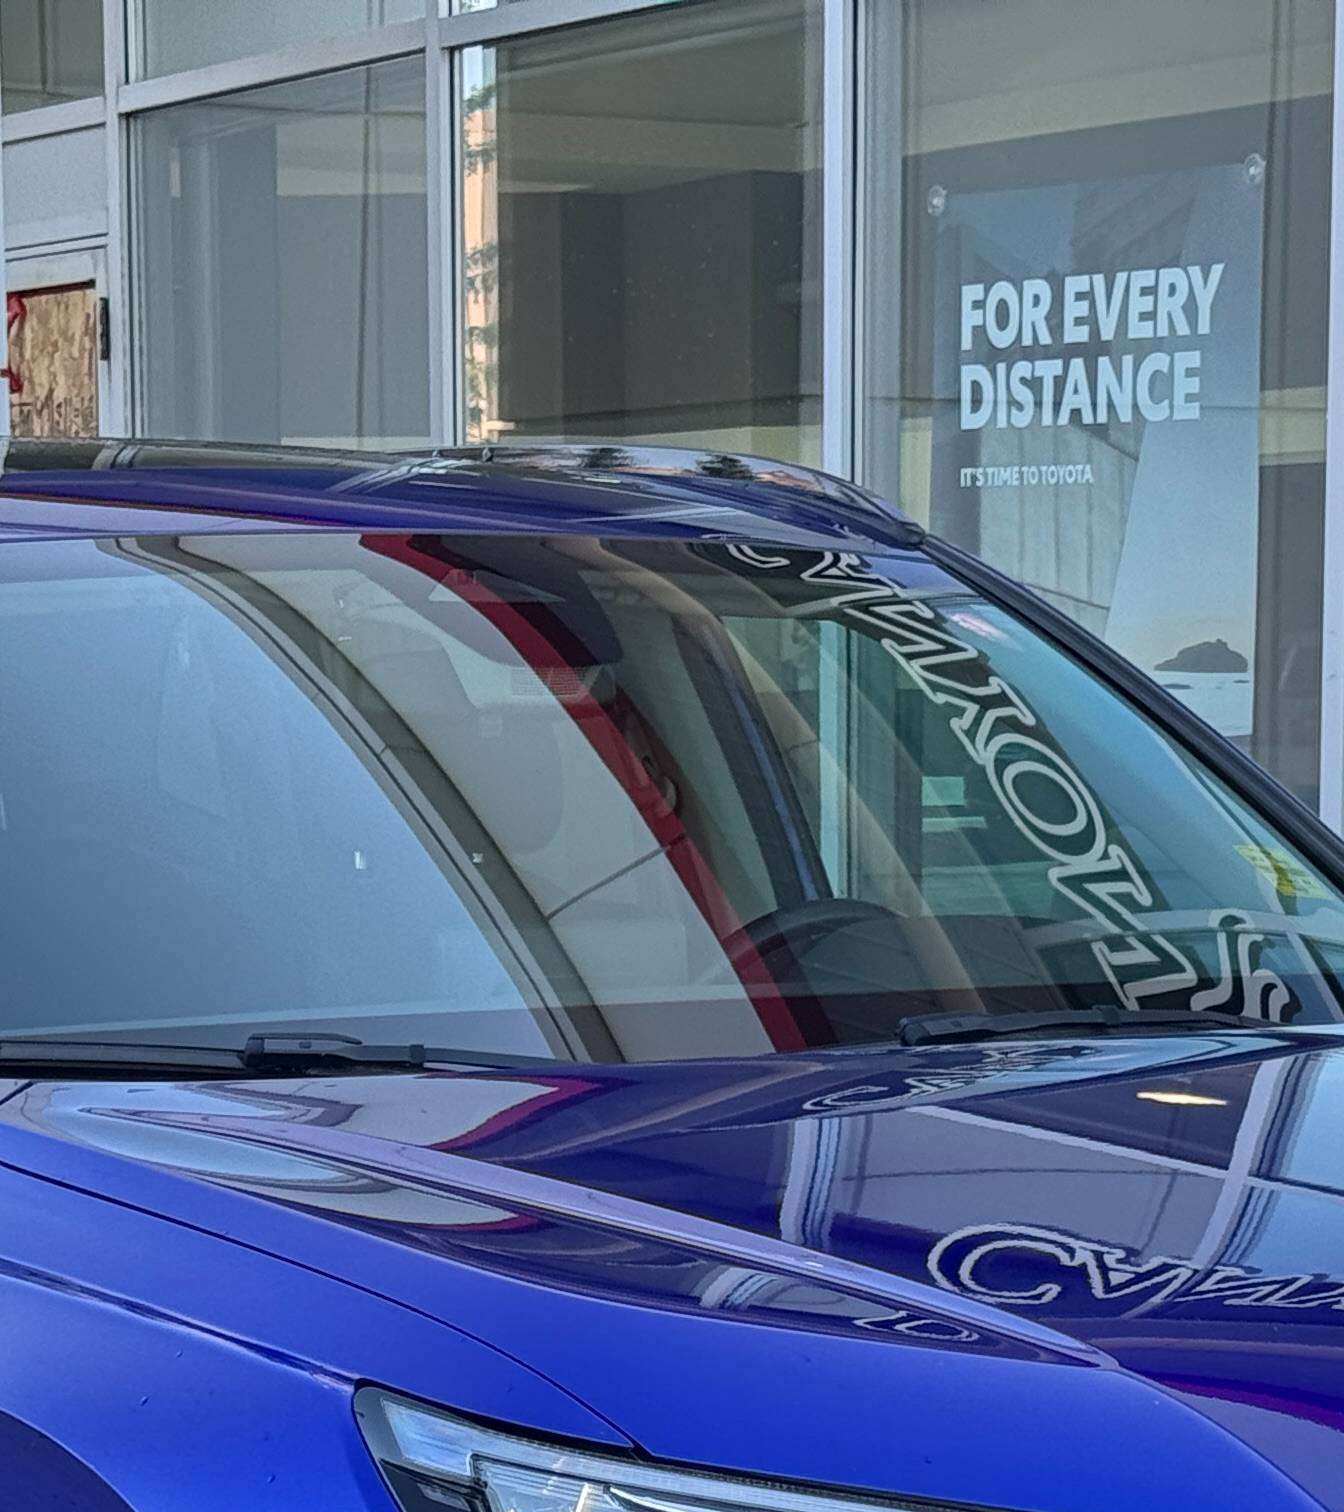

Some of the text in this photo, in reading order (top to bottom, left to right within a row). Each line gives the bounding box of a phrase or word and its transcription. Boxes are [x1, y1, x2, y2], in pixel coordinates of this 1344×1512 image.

[960, 263, 1225, 350] FOR EVERY
[960, 351, 1201, 430] DISTANCE
[959, 464, 1094, 488] IT'S TIME TO TOYOTA
